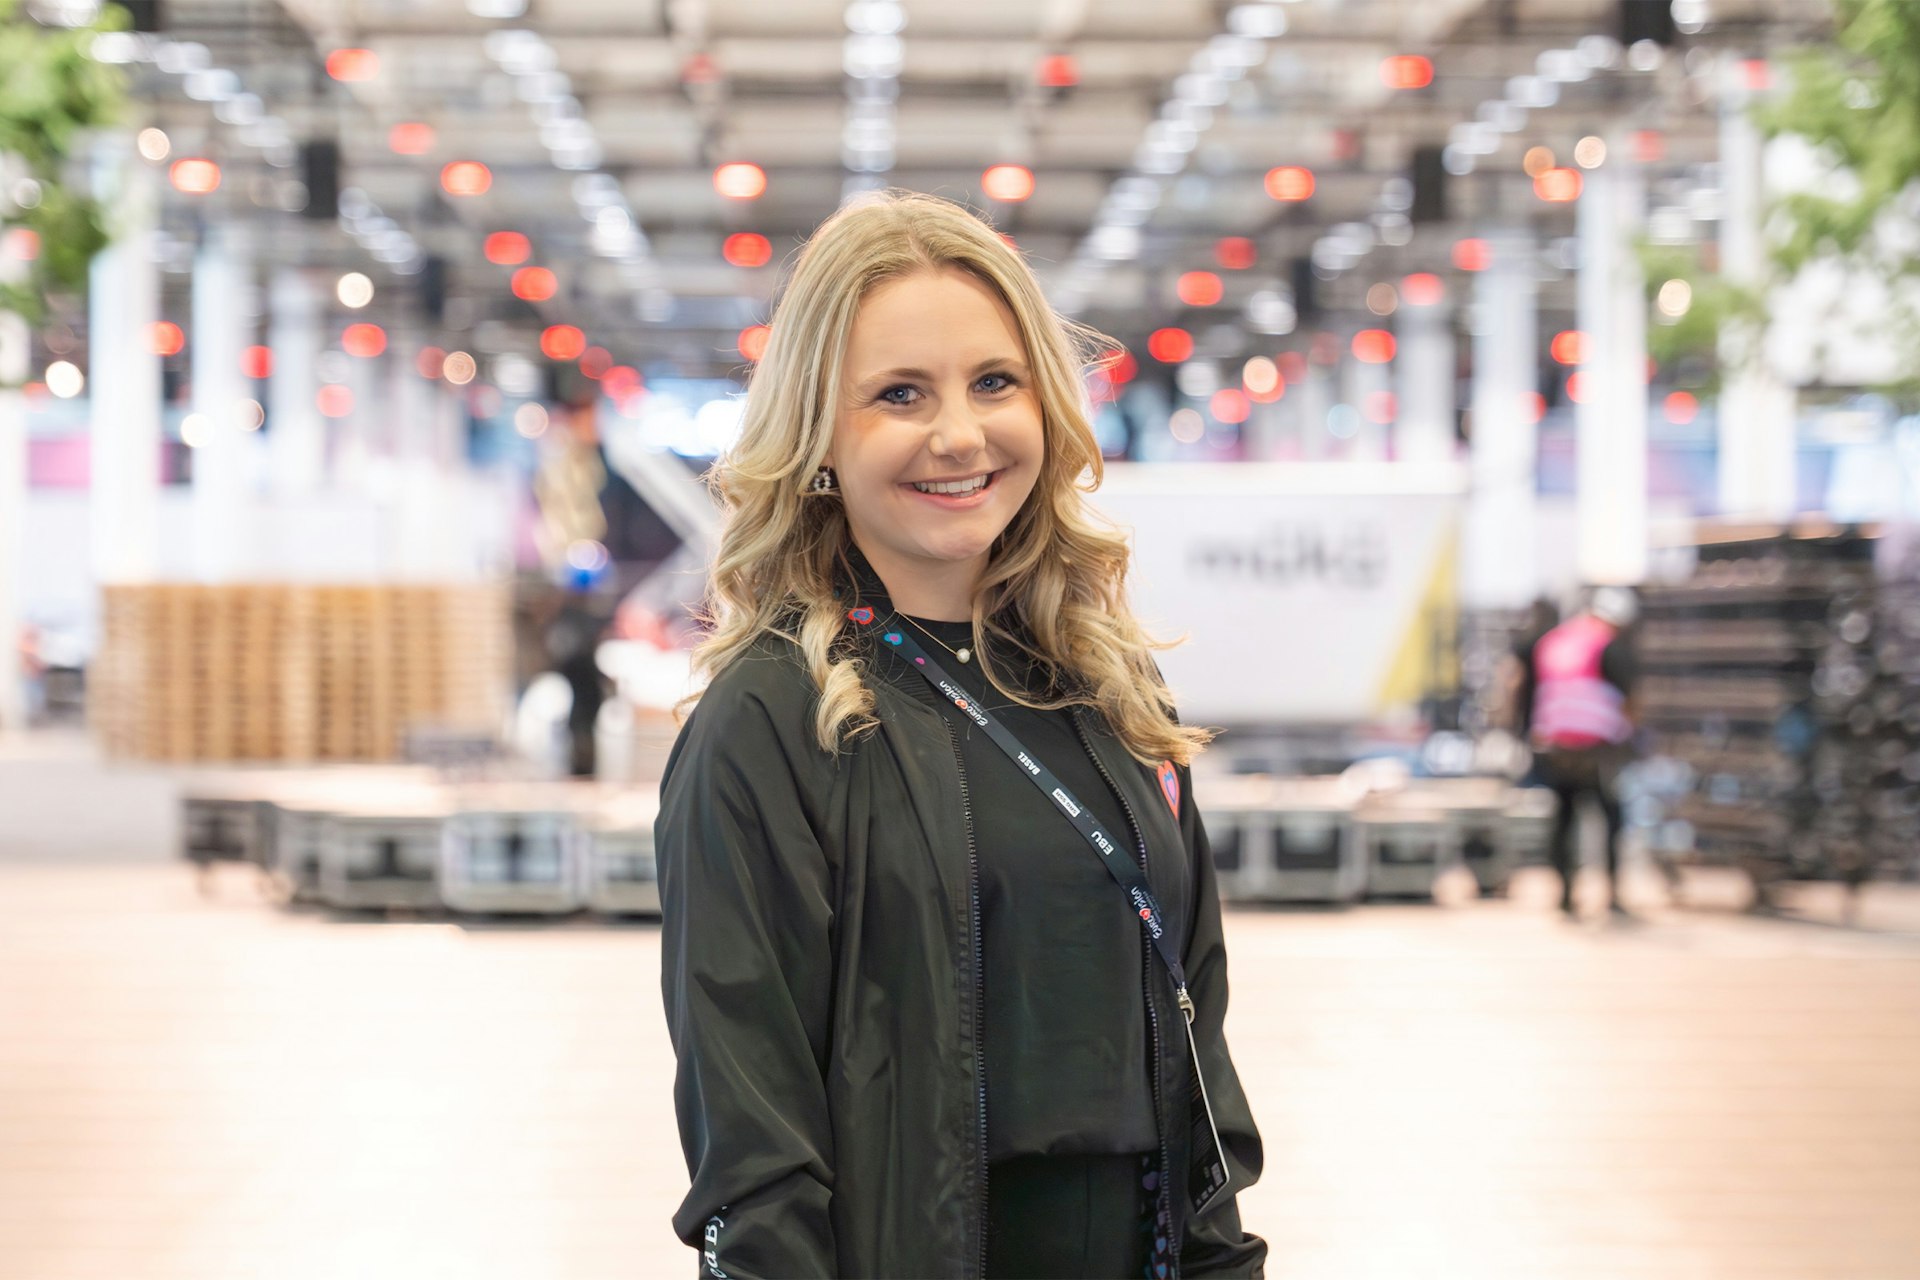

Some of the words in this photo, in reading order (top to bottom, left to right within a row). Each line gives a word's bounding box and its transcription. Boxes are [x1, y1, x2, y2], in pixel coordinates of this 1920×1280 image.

[1017, 751, 1041, 776] BASEL
[1091, 830, 1114, 856] EBU
[705, 1215, 725, 1247] By
